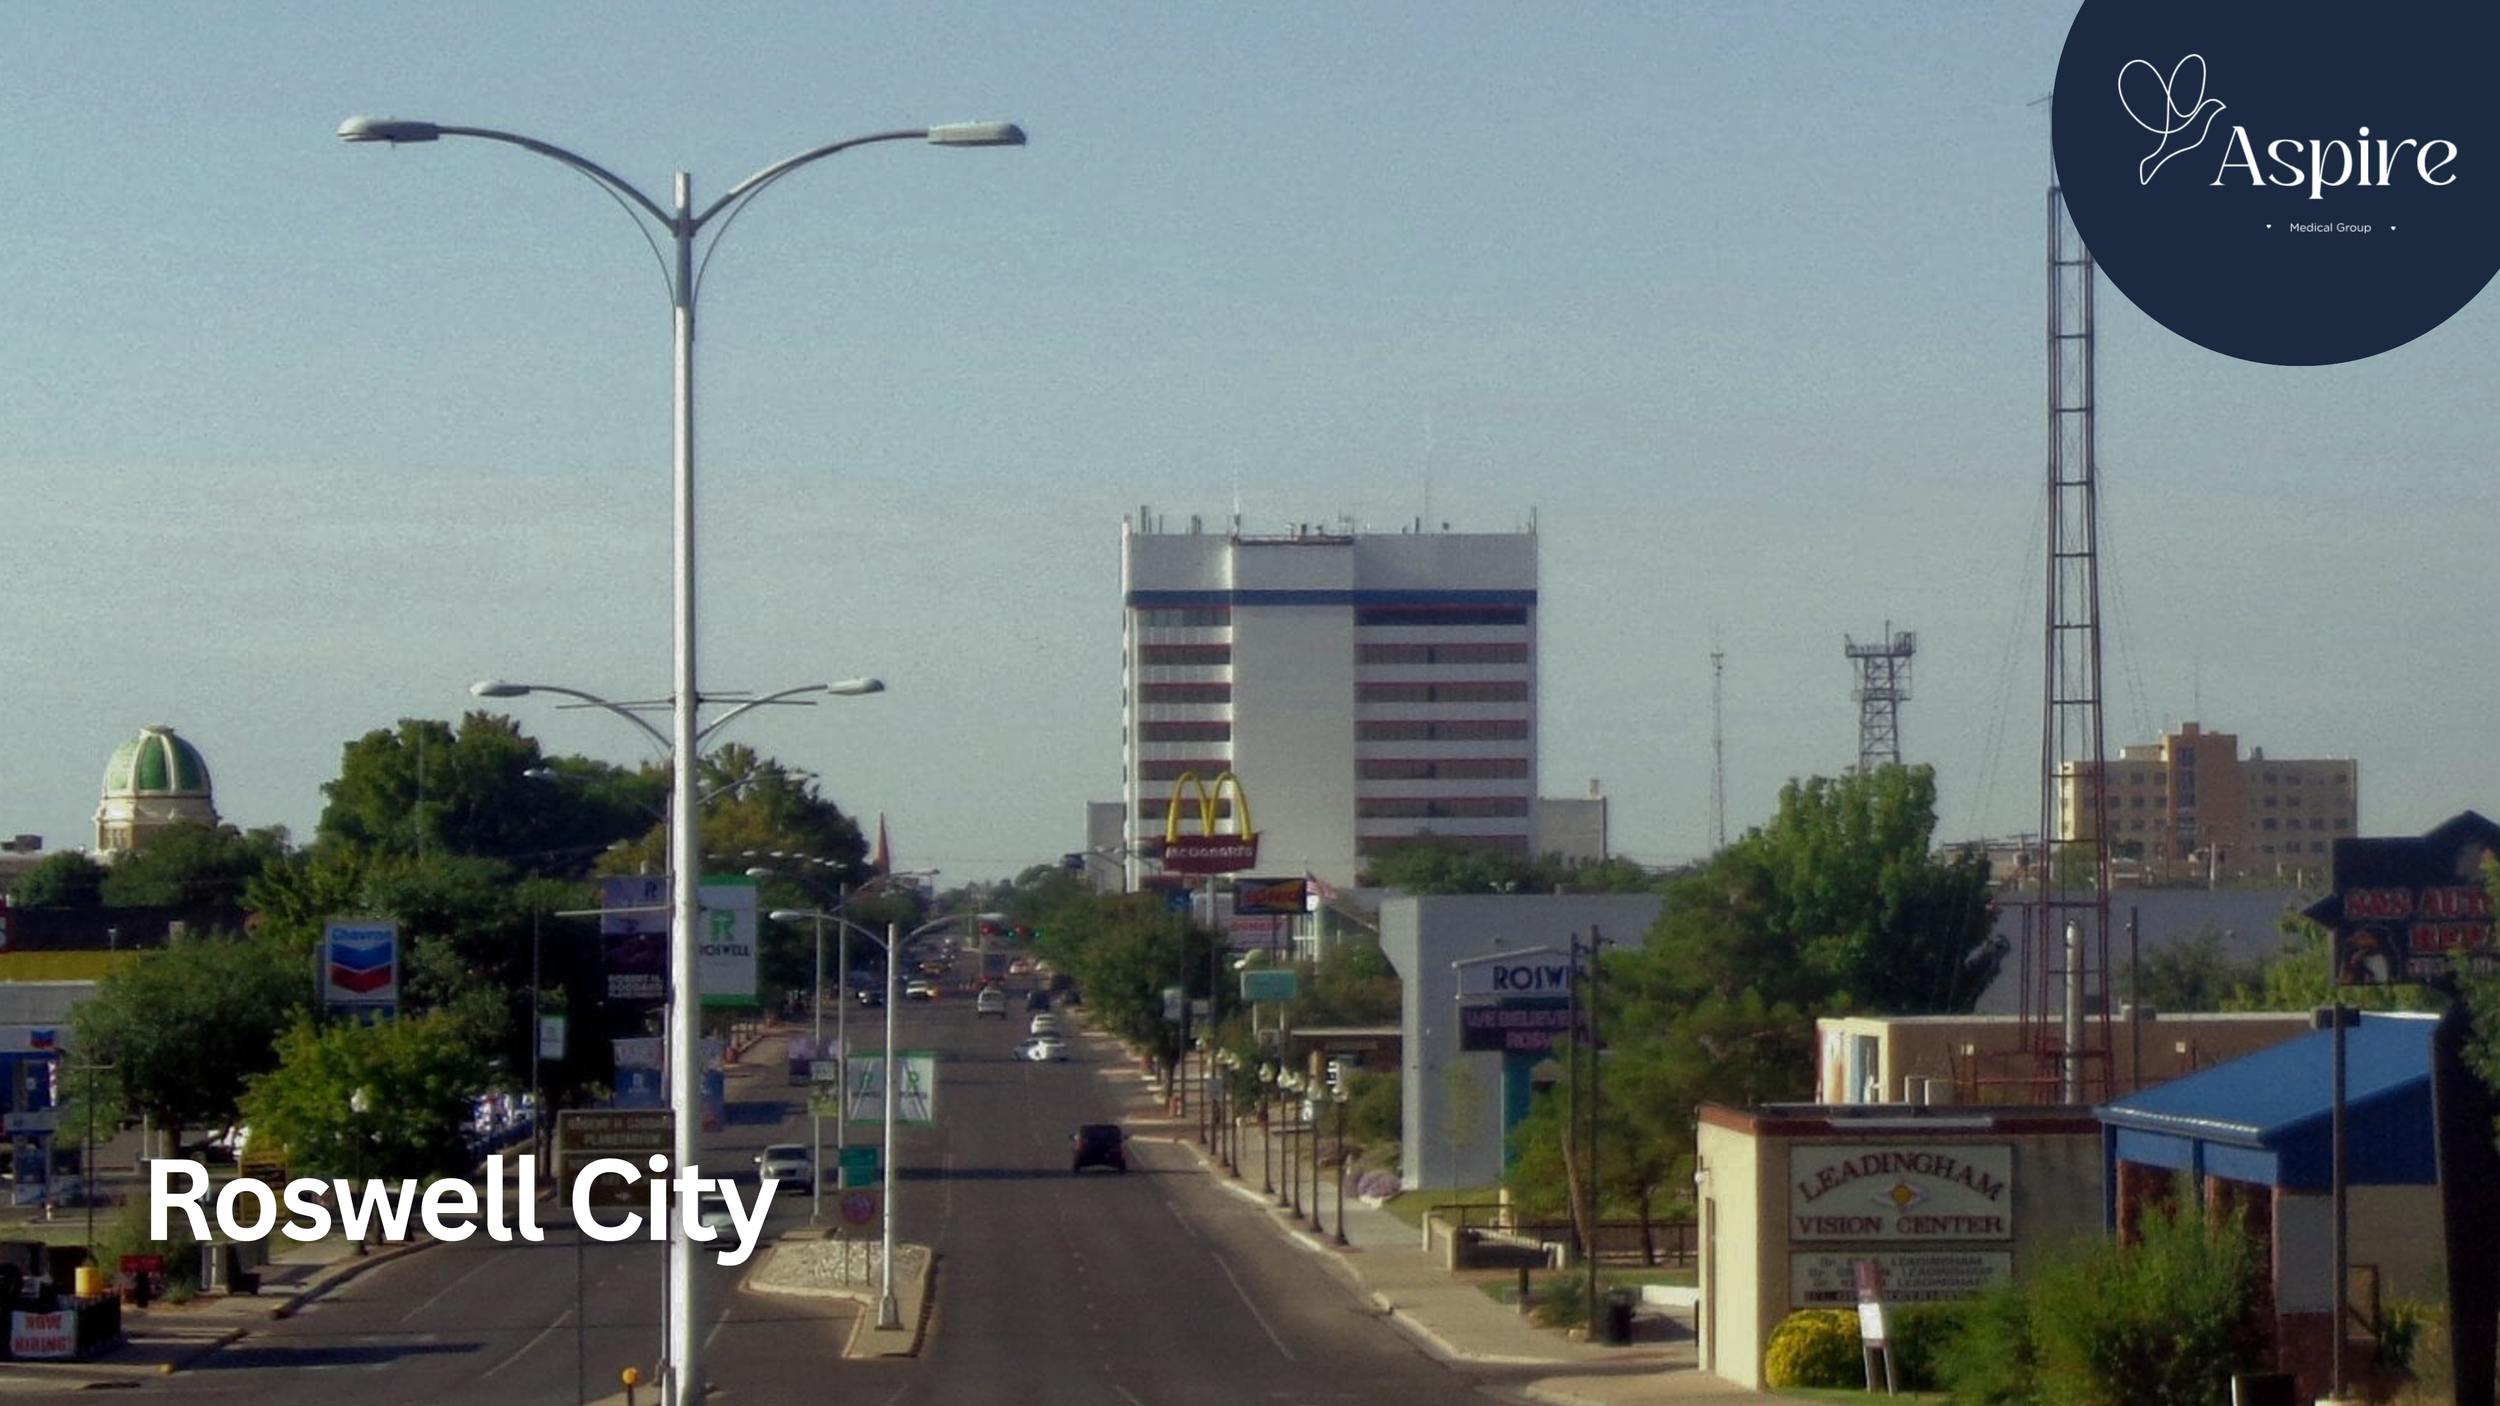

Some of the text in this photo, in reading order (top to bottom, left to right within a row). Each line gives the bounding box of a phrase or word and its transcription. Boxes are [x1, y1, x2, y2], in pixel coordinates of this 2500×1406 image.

[1796, 1152, 2005, 1202] LEADINGHAM
[1796, 1215, 2004, 1234] VISION CENTER
